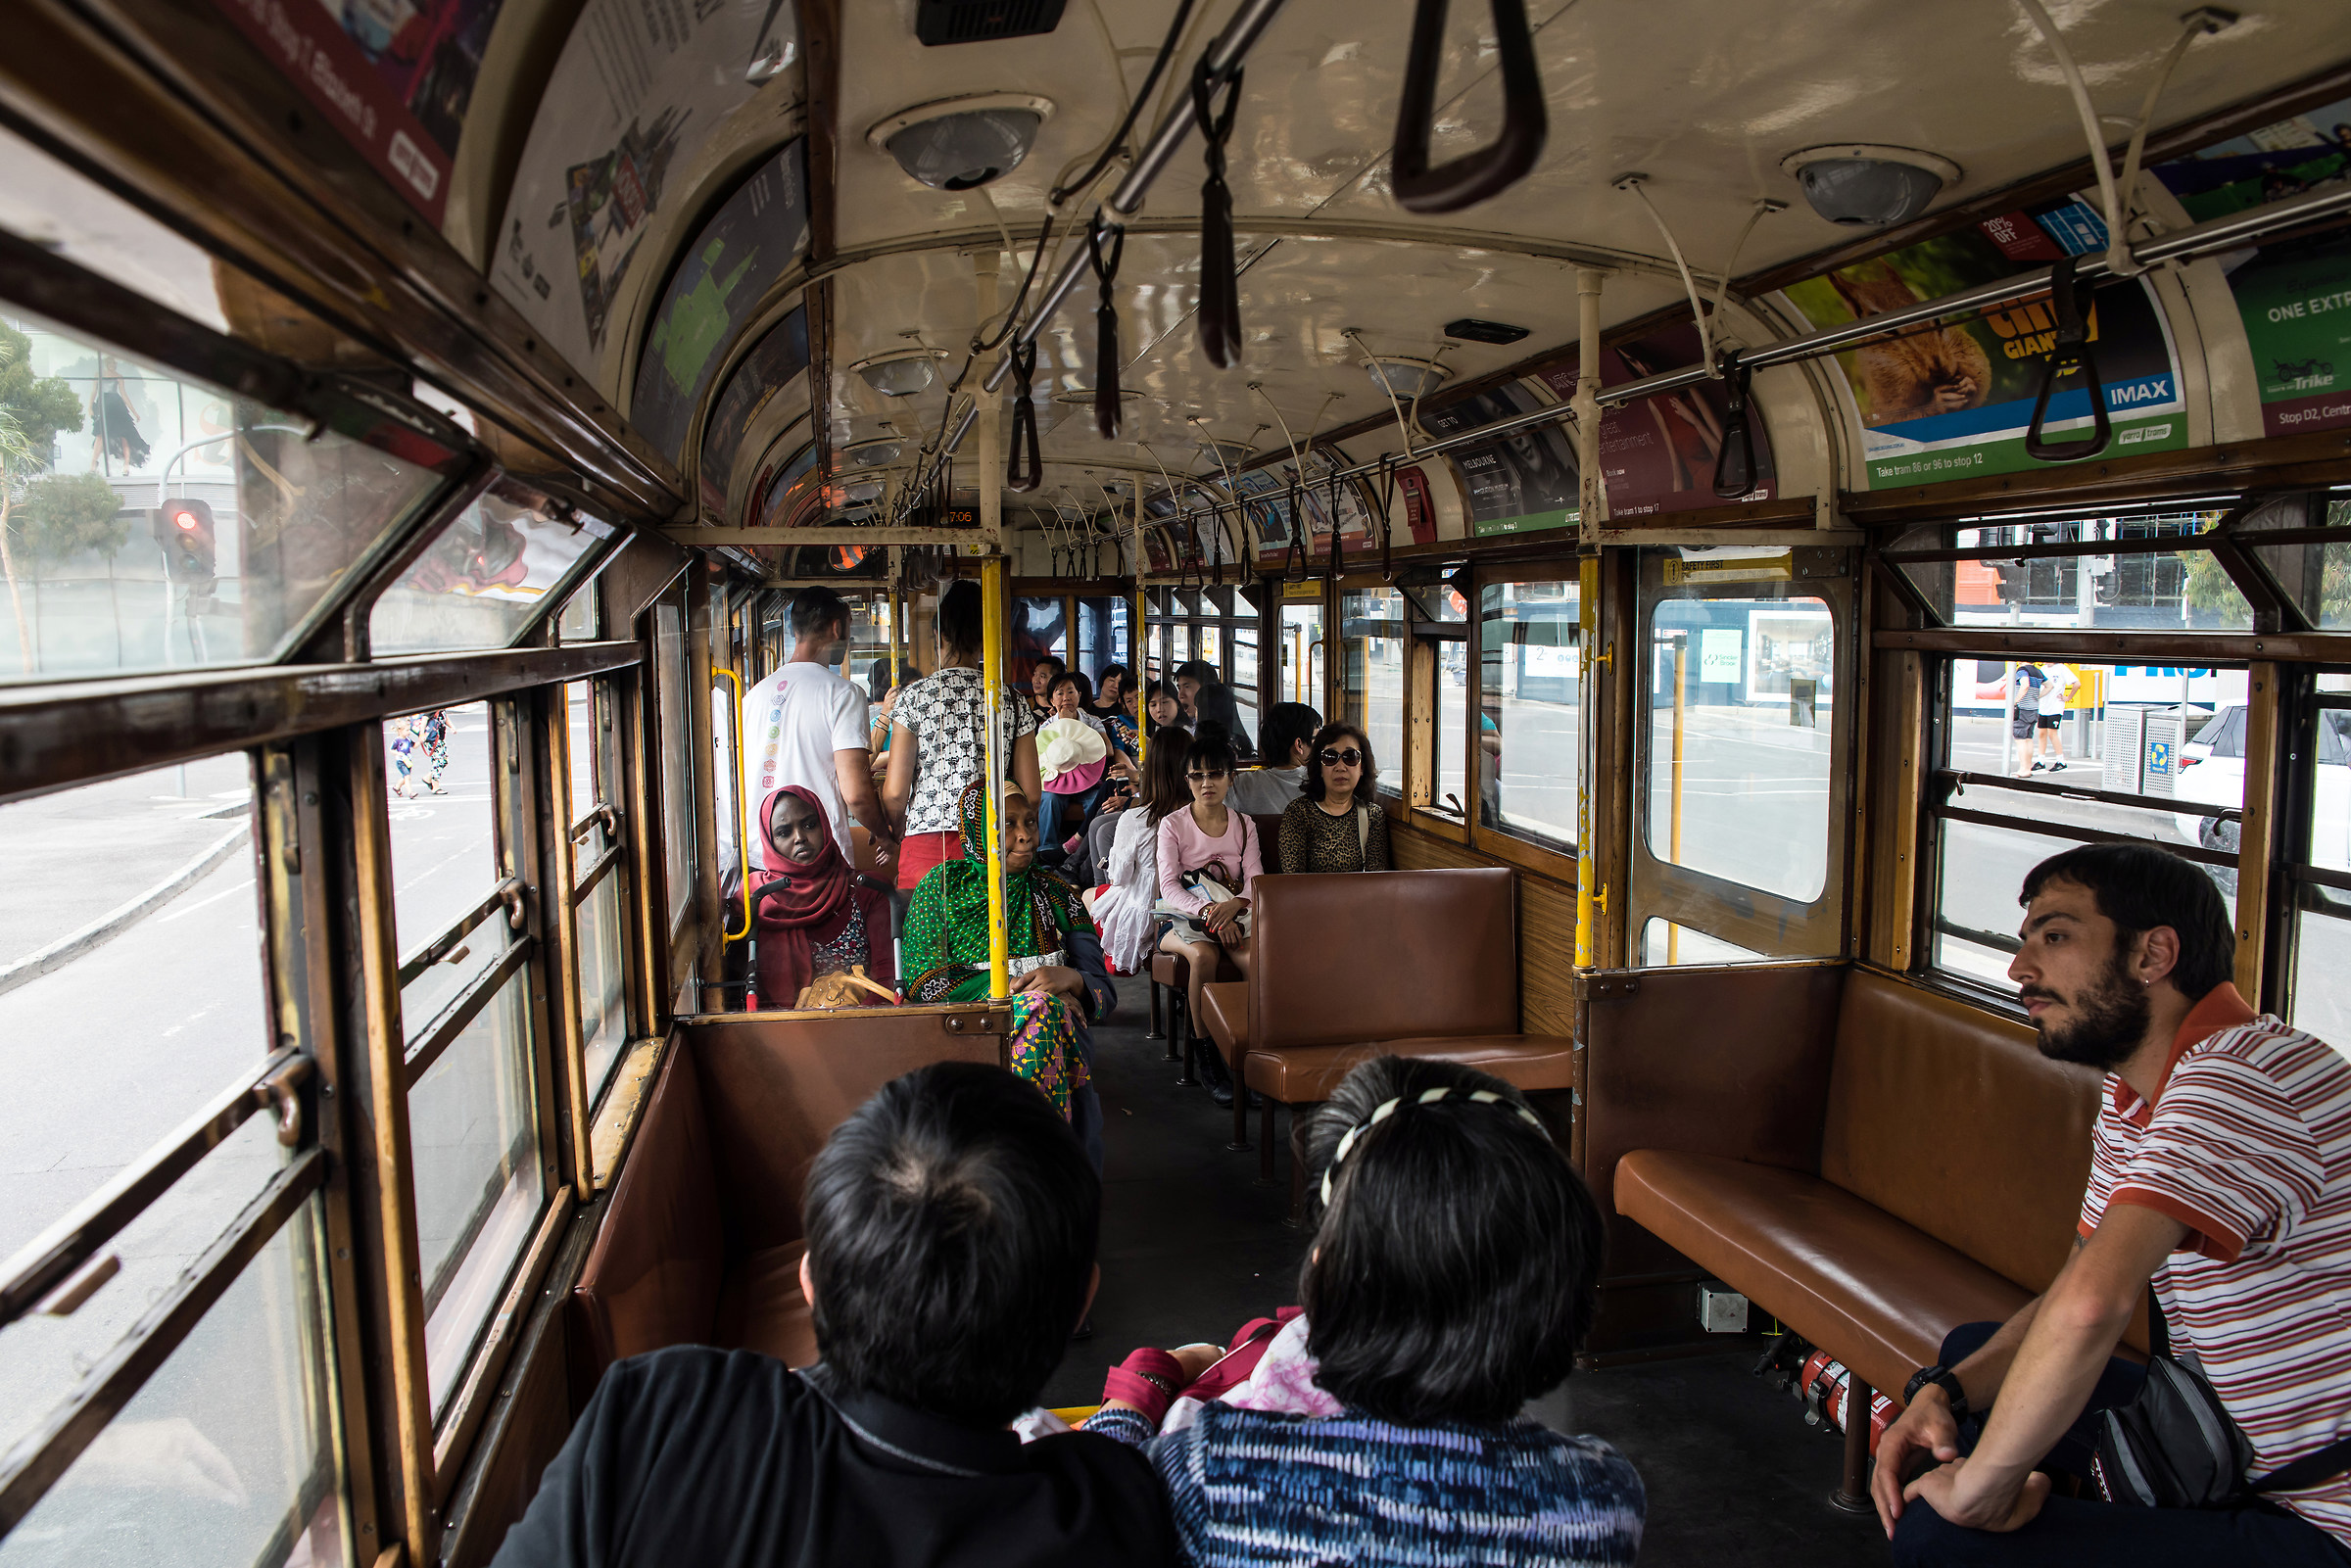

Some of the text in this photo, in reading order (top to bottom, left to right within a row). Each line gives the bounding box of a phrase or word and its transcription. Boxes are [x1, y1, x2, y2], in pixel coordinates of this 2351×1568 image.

[1983, 215, 2014, 232] 20%
[1994, 227, 2018, 245] OFF
[2268, 302, 2307, 322] ONE
[2293, 373, 2334, 391] Trike
[2111, 379, 2169, 405] IMAX
[1437, 416, 1458, 428] GET TO
[2279, 403, 2351, 425] Stop D2, Centr
[1599, 421, 1621, 440] great
[2122, 425, 2169, 444] yarra trams
[1598, 432, 1655, 454] entertainment
[1462, 453, 1497, 470] MELBOURNE
[1876, 452, 1983, 479] Take tram 86 or 96 to stop 12
[1606, 468, 1616, 477] Book
[1613, 507, 1623, 517] Take
[1623, 506, 1634, 515] tram
[1643, 503, 1654, 515] stop
[1654, 502, 1659, 511] 17
[1681, 559, 1724, 571] SAFETY FIRST
[1536, 646, 1545, 660] 2
